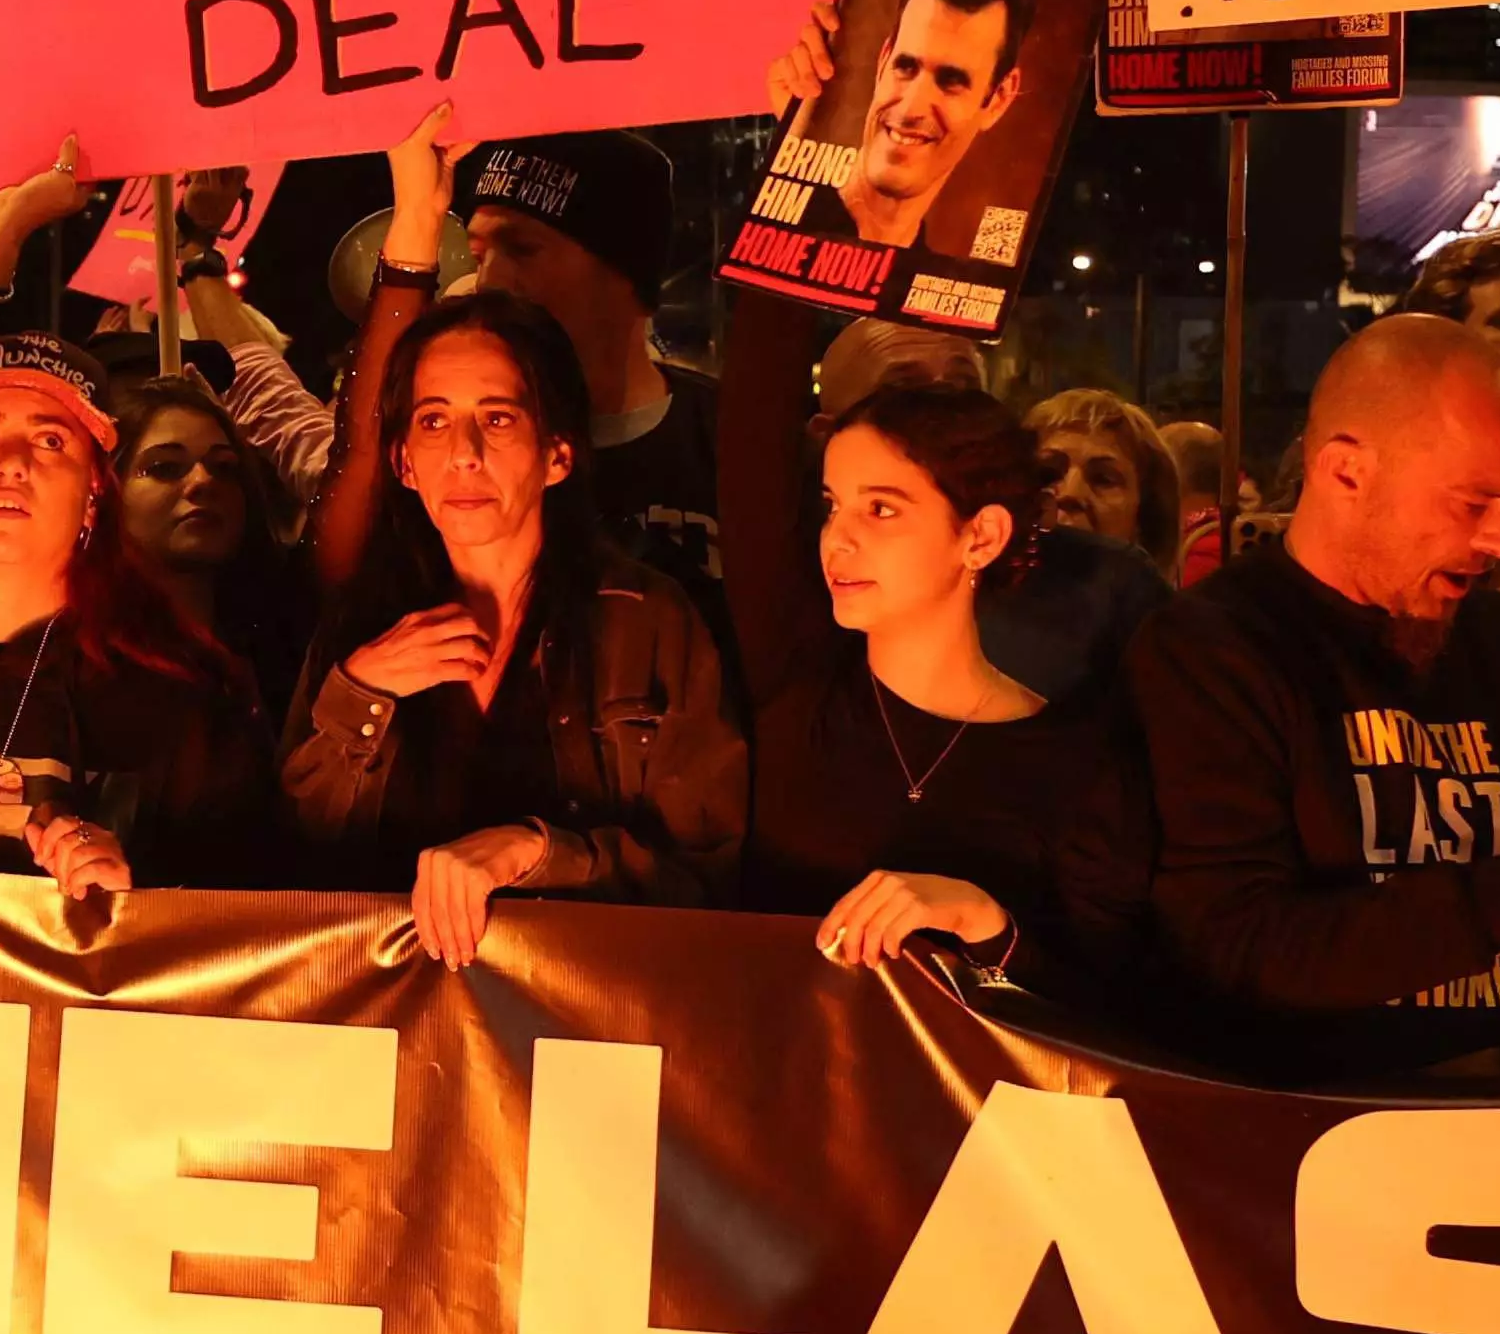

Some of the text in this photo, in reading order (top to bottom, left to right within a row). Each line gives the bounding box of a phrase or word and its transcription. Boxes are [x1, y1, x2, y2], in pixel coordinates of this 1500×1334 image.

[1108, 43, 1263, 90] HOME NOW!
[1291, 67, 1389, 88] FAMILIES FORUM
[769, 134, 860, 188] BRING
[751, 175, 815, 225] HIM
[729, 221, 897, 295] HOME NOW!
[1425, 720, 1500, 776] THE
